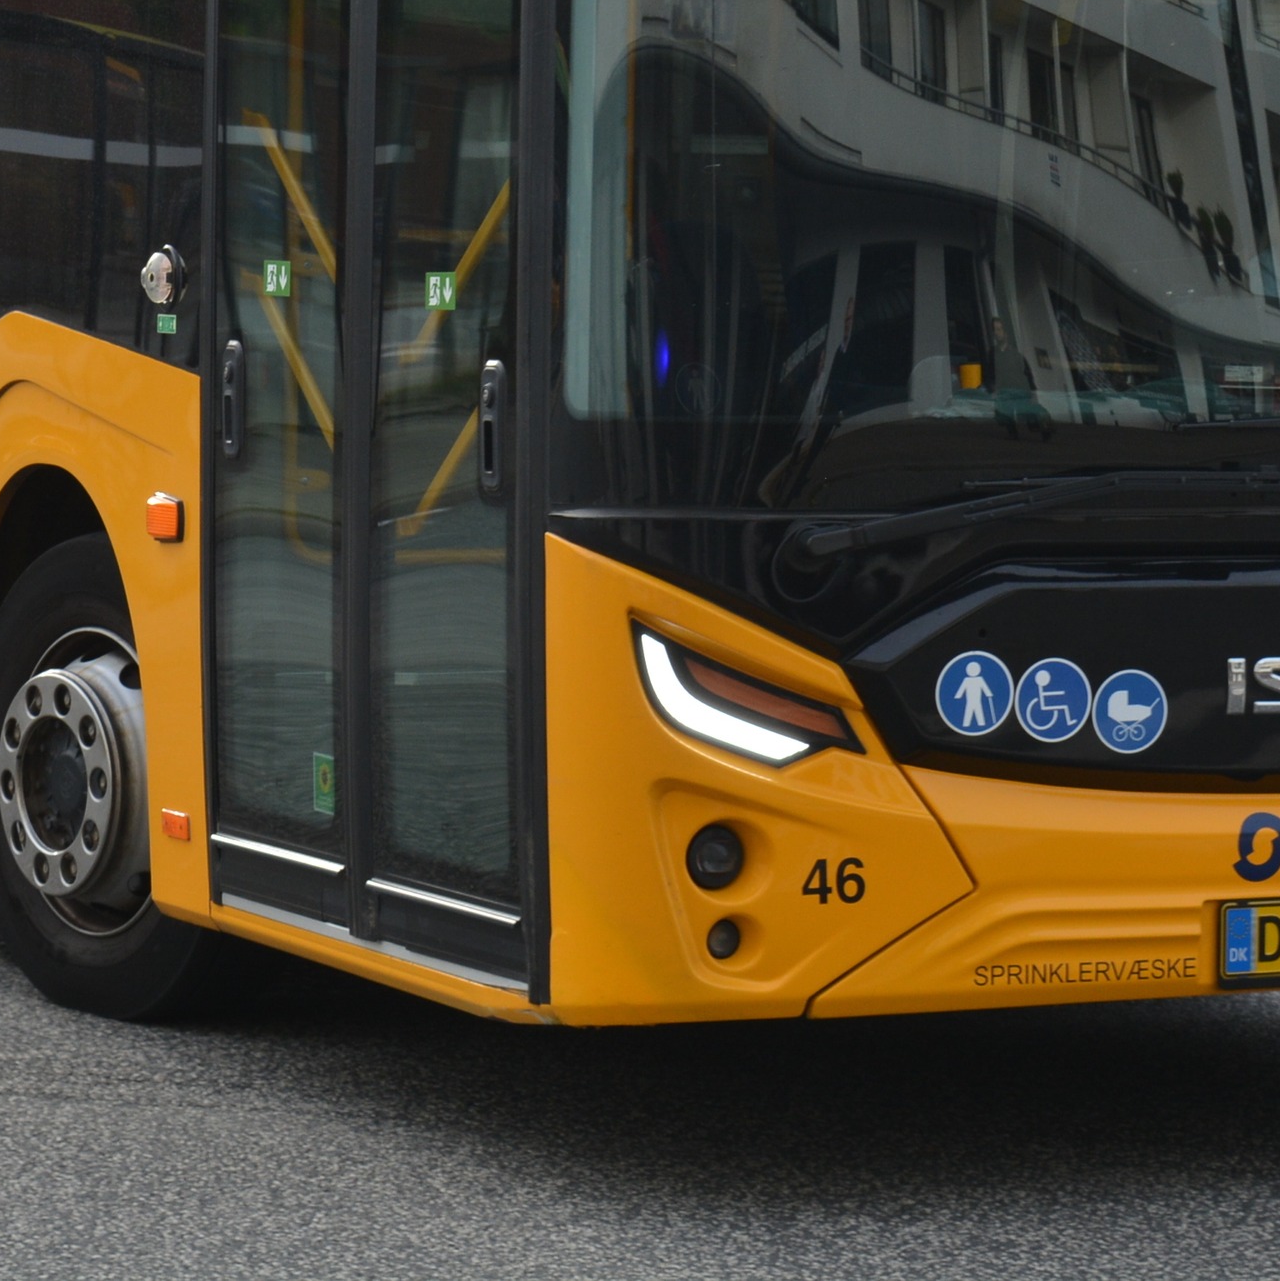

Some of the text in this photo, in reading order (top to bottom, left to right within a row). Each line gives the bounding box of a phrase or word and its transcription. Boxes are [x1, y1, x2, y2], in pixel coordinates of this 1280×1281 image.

[802, 857, 866, 905] 46
[1229, 947, 1248, 963] DK
[973, 957, 1197, 987] SPRINKLERVÆSKE
